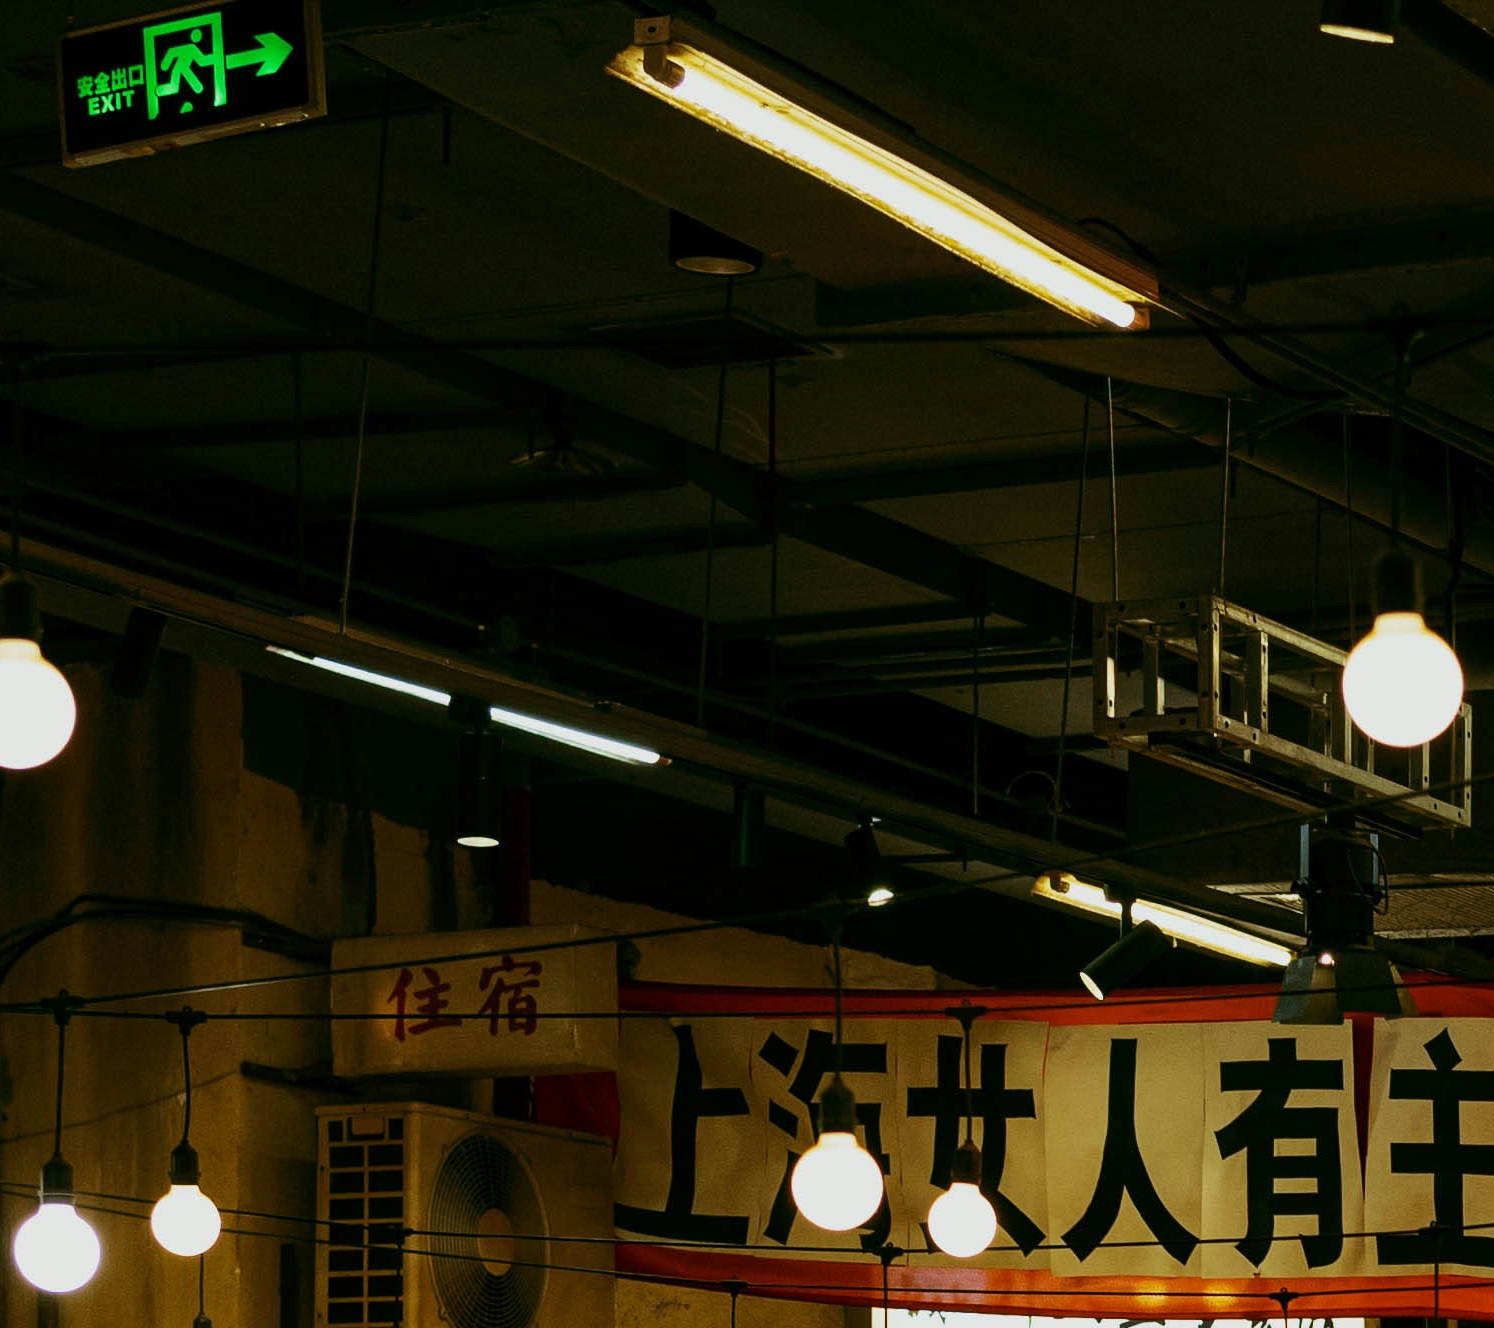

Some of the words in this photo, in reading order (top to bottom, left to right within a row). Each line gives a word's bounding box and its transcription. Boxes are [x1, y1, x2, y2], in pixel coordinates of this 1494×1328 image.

[77, 64, 144, 98] 安全出口
[88, 90, 135, 116] EXIT
[387, 956, 544, 1042] 住宿
